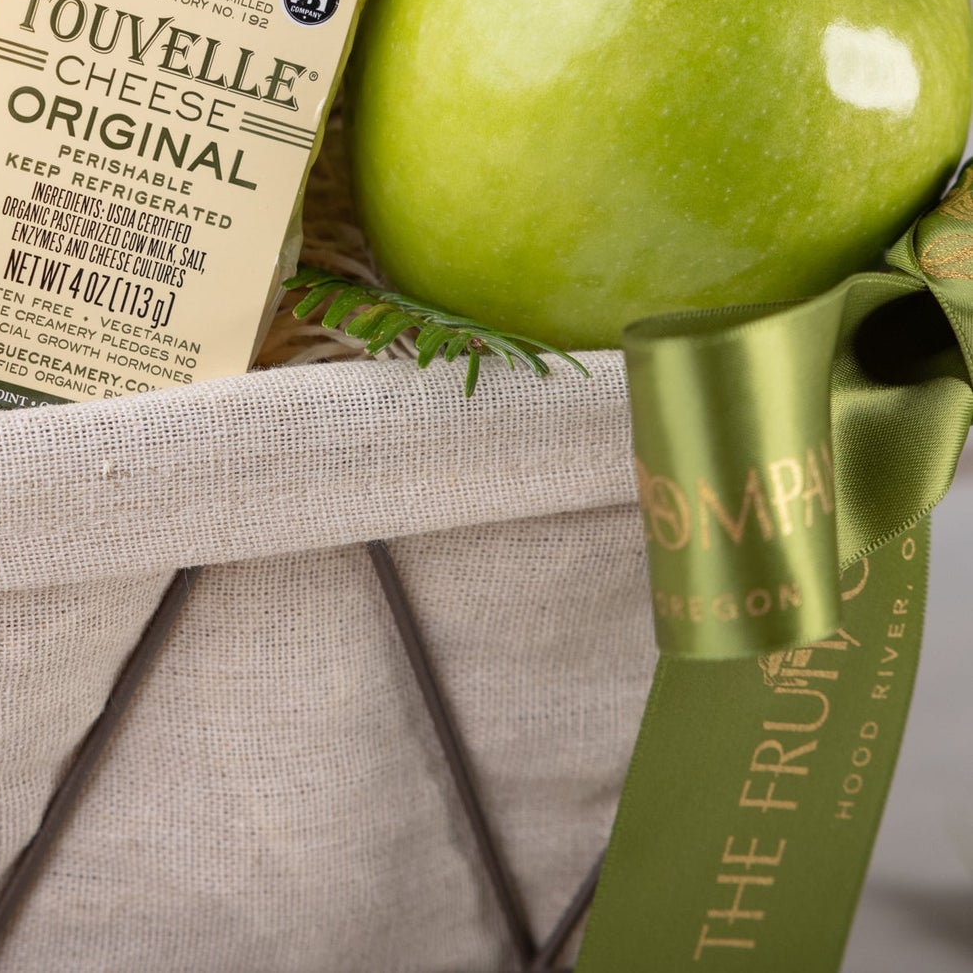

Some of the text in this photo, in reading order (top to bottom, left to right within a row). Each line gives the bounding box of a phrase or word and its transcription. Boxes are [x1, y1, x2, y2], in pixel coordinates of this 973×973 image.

[212, 3, 235, 19] NO.
[242, 12, 270, 29] 192
[290, 5, 322, 20] COMPANY
[55, 55, 236, 132] CHEESE
[7, 85, 258, 191] ORIGINAL
[5, 152, 233, 230] KEEP REFRIGERATED
[58, 144, 194, 196] PERISHABLE
[2, 196, 208, 275] ORGANIC PASTEURIZED COW MILK, SALT,
[31, 181, 192, 245] INGREDIENTS: USDA CERTIFIED
[3, 248, 42, 287] NET
[39, 258, 71, 295] WT
[68, 267, 84, 300] 4
[83, 271, 111, 308] OZ
[11, 222, 187, 289] ENZYMES AND CHEESE CULTURES
[14, 309, 97, 340] CREAMERY
[101, 333, 169, 361] PLEDGES
[174, 354, 197, 369] NO
[31, 297, 75, 318] FREE
[100, 316, 202, 355] VEGETARIAN
[34, 370, 97, 396] ORGANIC
[37, 333, 101, 359] GROWTH
[106, 351, 193, 385] HORMONES
[835, 720, 879, 820] HOOD
[872, 584, 914, 700] RIVER,
[693, 835, 787, 961] THE
